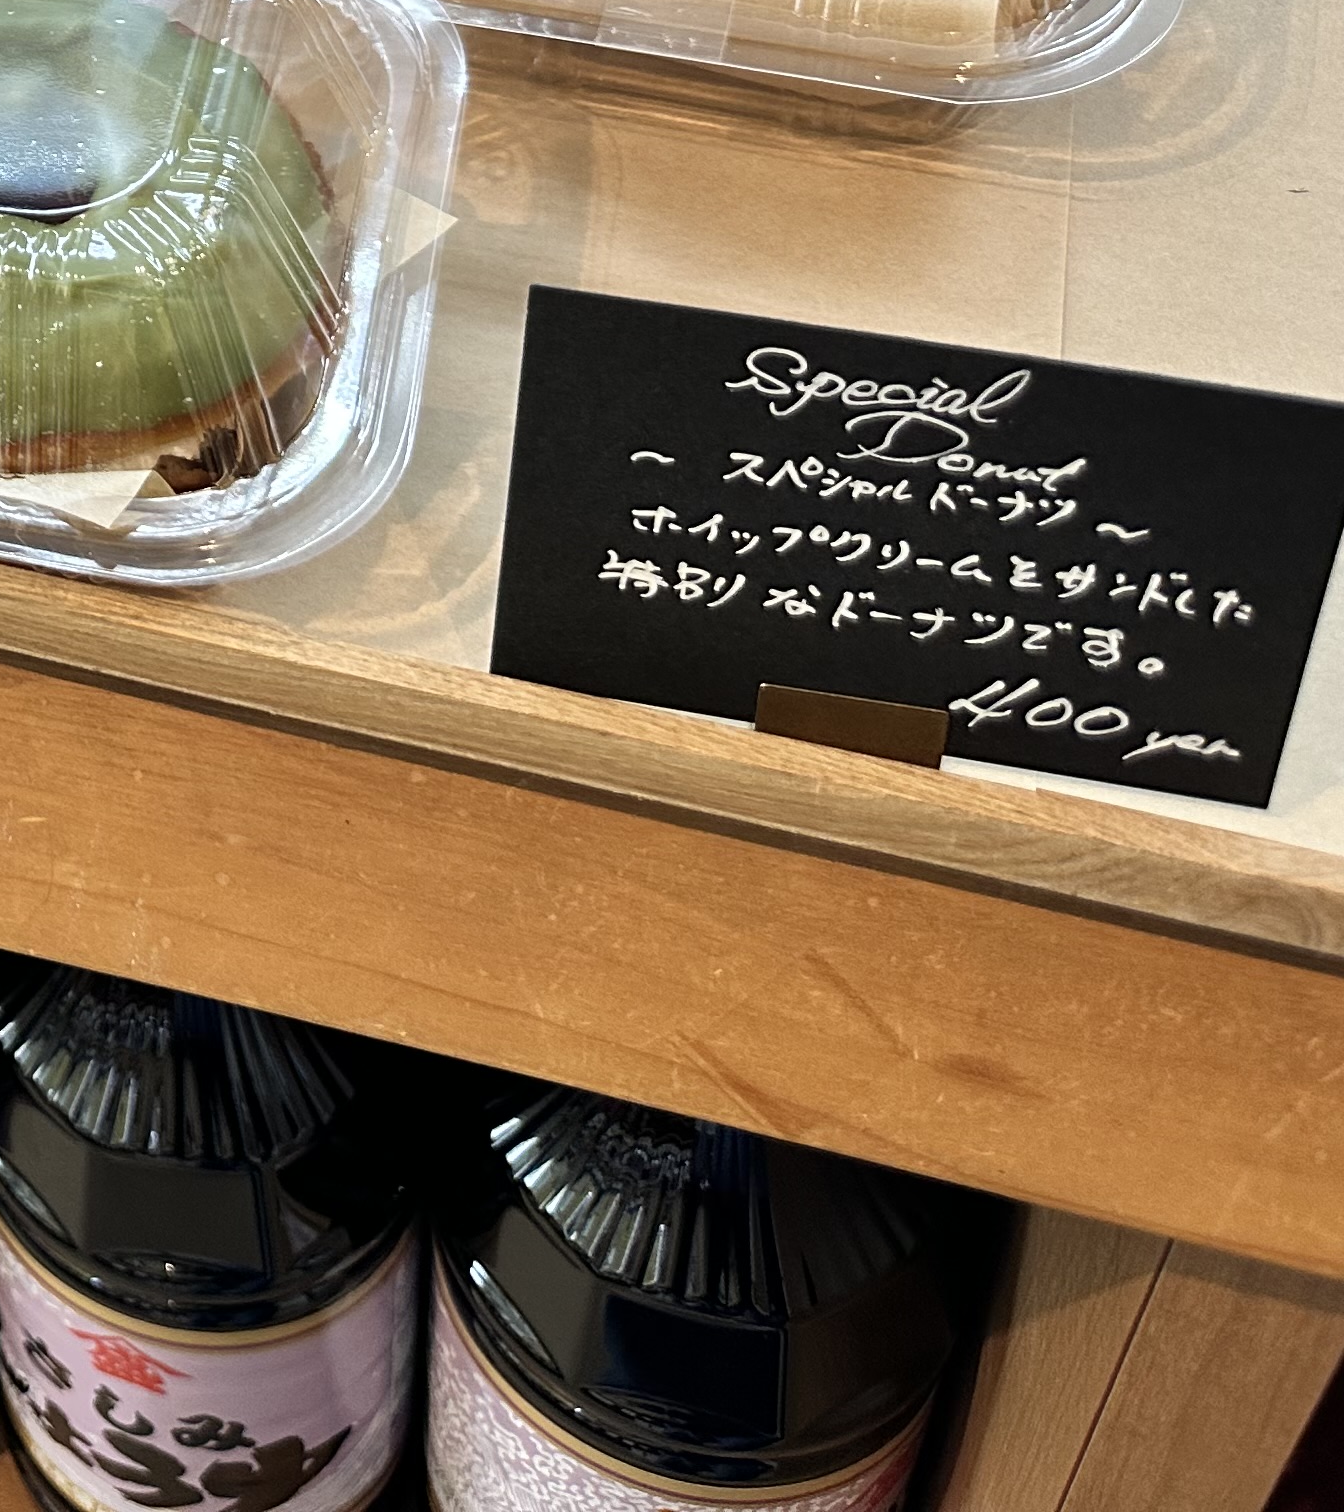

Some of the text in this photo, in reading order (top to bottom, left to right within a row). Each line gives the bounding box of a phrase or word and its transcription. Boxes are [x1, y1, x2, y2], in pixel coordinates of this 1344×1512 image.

[725, 346, 1033, 426] Special
[836, 412, 1089, 492] Donut
[631, 502, 1256, 624] ホイップクリームをサンドした
[597, 550, 1166, 678] 特別なドーナツです。
[948, 677, 1243, 761] 400 yen
